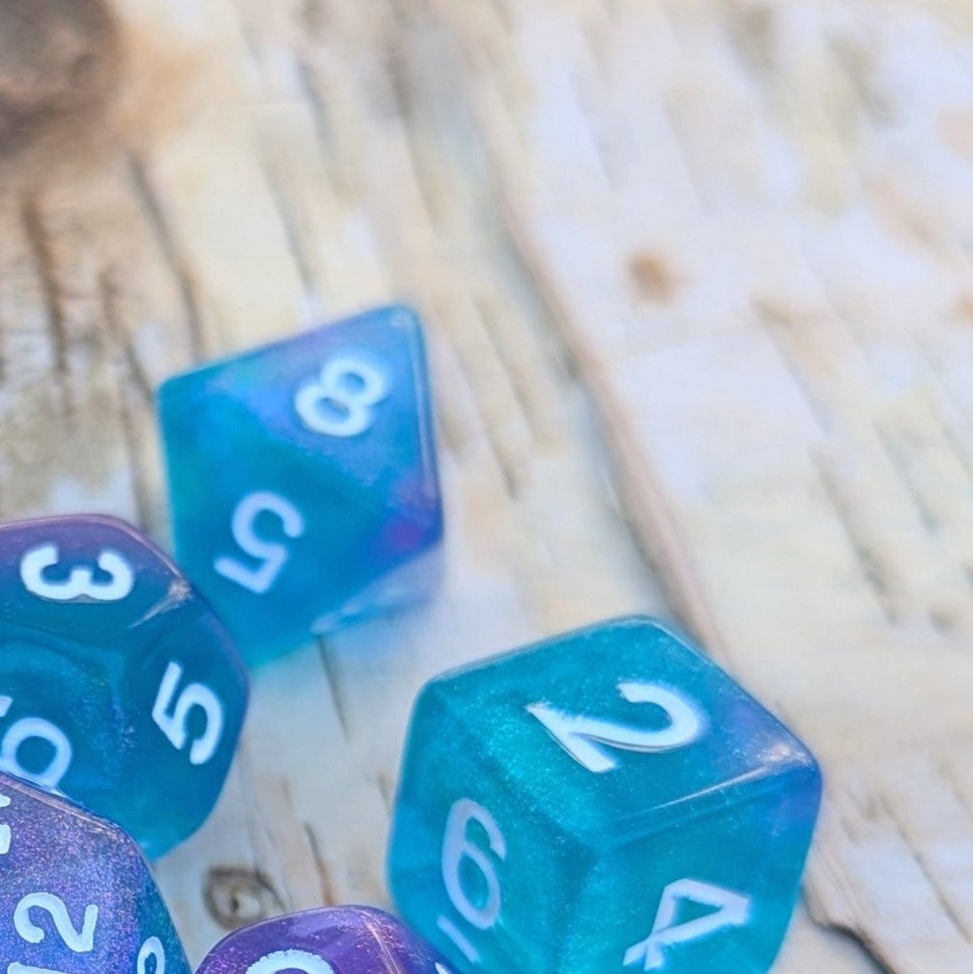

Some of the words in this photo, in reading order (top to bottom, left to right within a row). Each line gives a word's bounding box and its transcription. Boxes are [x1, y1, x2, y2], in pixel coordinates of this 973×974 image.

[293, 357, 387, 438] 8
[20, 543, 134, 602] 3
[214, 490, 305, 595] 5
[152, 660, 223, 765] 5
[527, 682, 702, 773] 2
[437, 798, 506, 963] 6
[623, 878, 752, 972] 4
